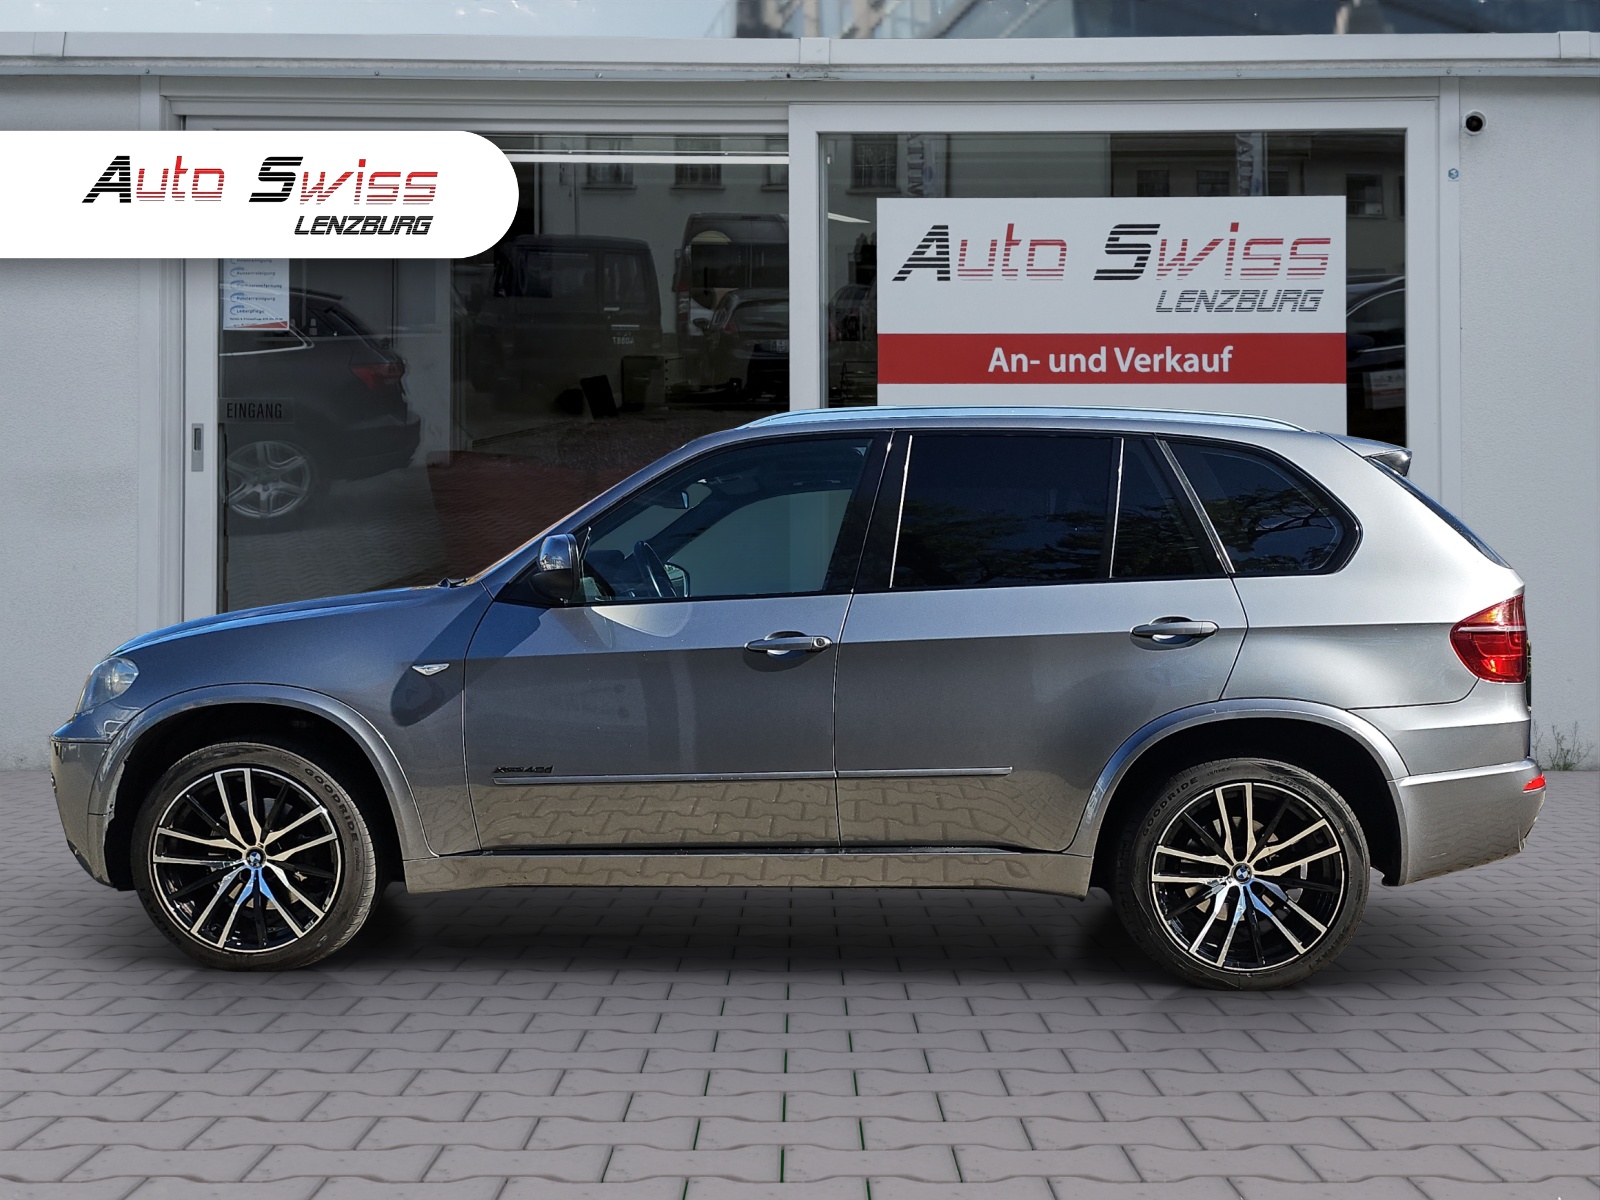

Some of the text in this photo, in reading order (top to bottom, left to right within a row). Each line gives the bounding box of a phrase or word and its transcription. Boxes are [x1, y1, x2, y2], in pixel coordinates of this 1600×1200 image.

[892, 221, 1331, 282] Auto Swiss
[1155, 288, 1325, 313] LENZBURG
[988, 344, 1234, 374] An- und Verkauf
[226, 402, 283, 419] EINGANG
[304, 767, 359, 842] GOODRIDE
[1142, 776, 1199, 837] GOODRIDE
